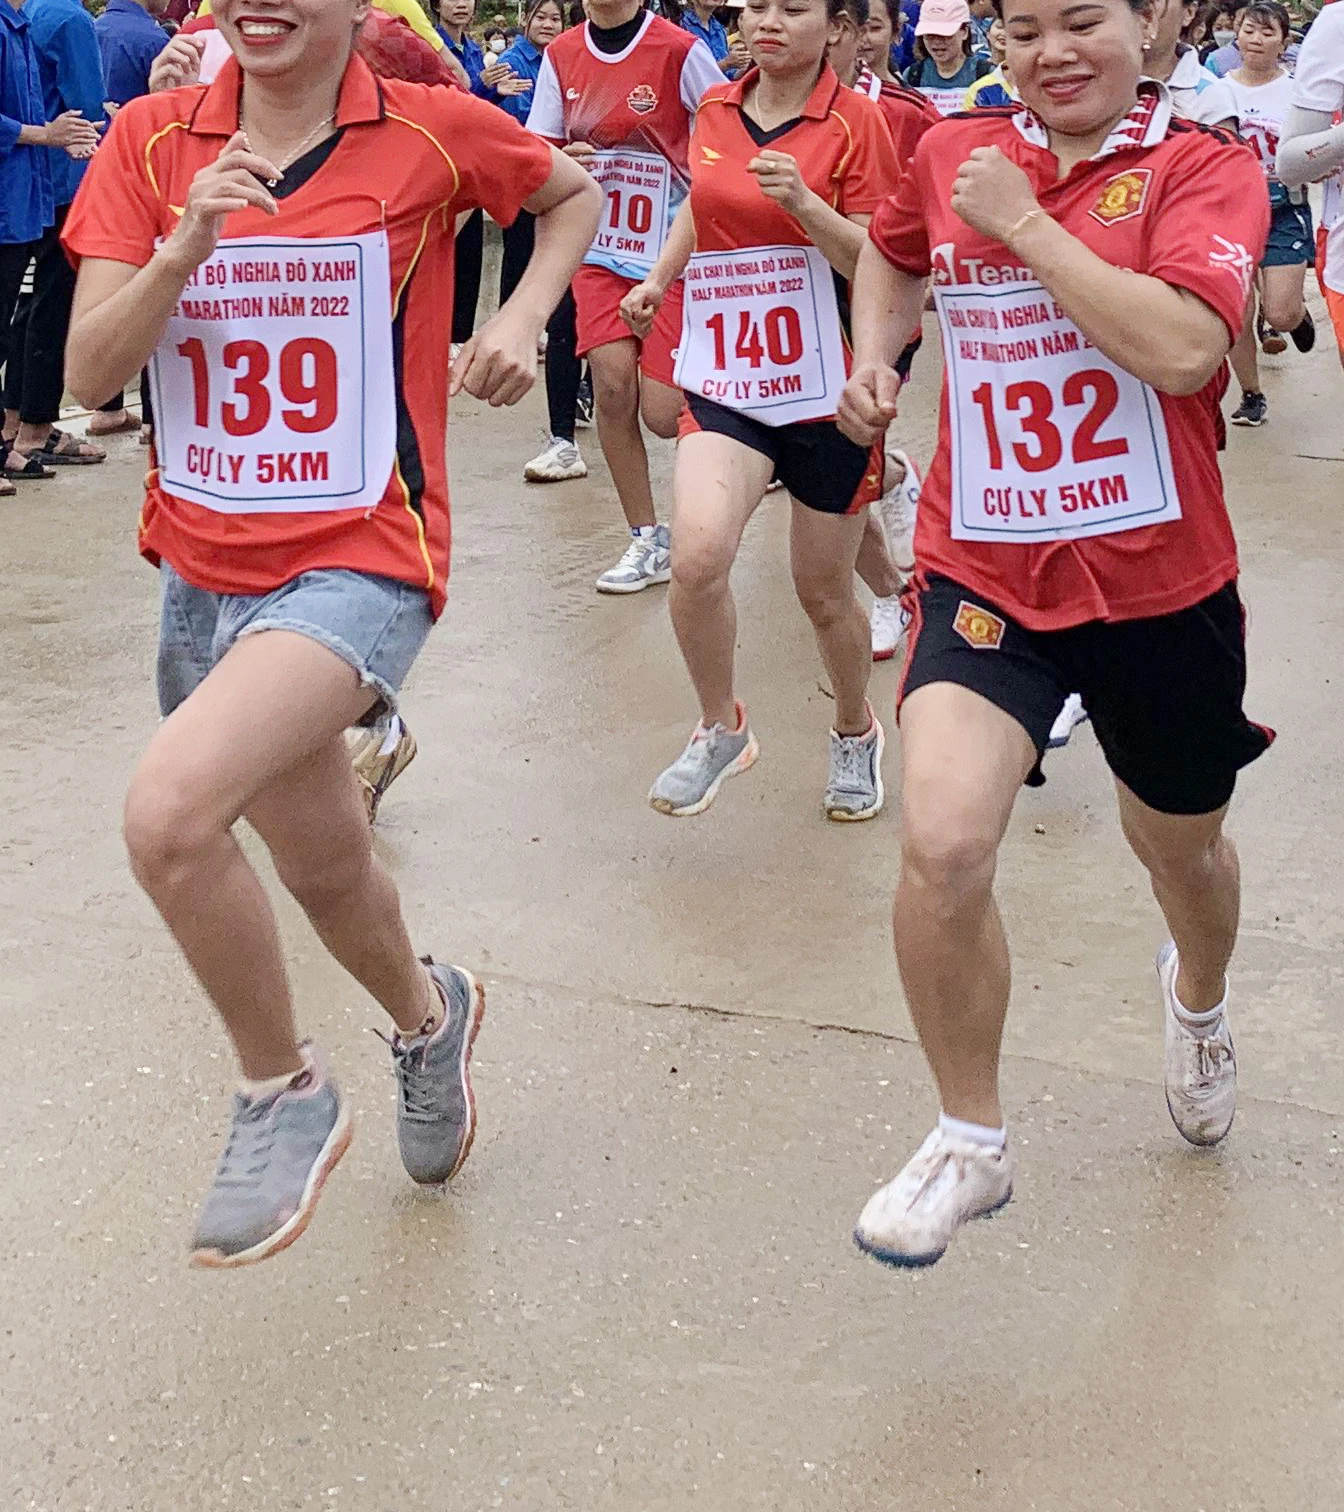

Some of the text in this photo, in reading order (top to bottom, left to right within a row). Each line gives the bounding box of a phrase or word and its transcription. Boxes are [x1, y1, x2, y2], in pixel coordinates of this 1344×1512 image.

[607, 189, 653, 234] 10
[616, 237, 645, 254] 5KM
[206, 260, 227, 289] BỘ
[312, 260, 356, 283] XANH
[777, 256, 806, 271] XANH
[691, 287, 712, 301] HALF
[779, 277, 804, 293] 2022
[181, 296, 263, 321] MARATHON
[268, 293, 305, 318] NĂM
[311, 296, 350, 317] 2022
[1001, 302, 1050, 329] NGHIA
[706, 306, 803, 370] 140
[1041, 330, 1080, 356] NĂM
[176, 337, 338, 437] 139
[735, 381, 752, 399] LY
[758, 374, 802, 398] 5KM
[971, 368, 1129, 473] 132
[187, 443, 329, 484] CỰ LY 5KM
[984, 474, 1129, 523] CỰ LY 5KM
